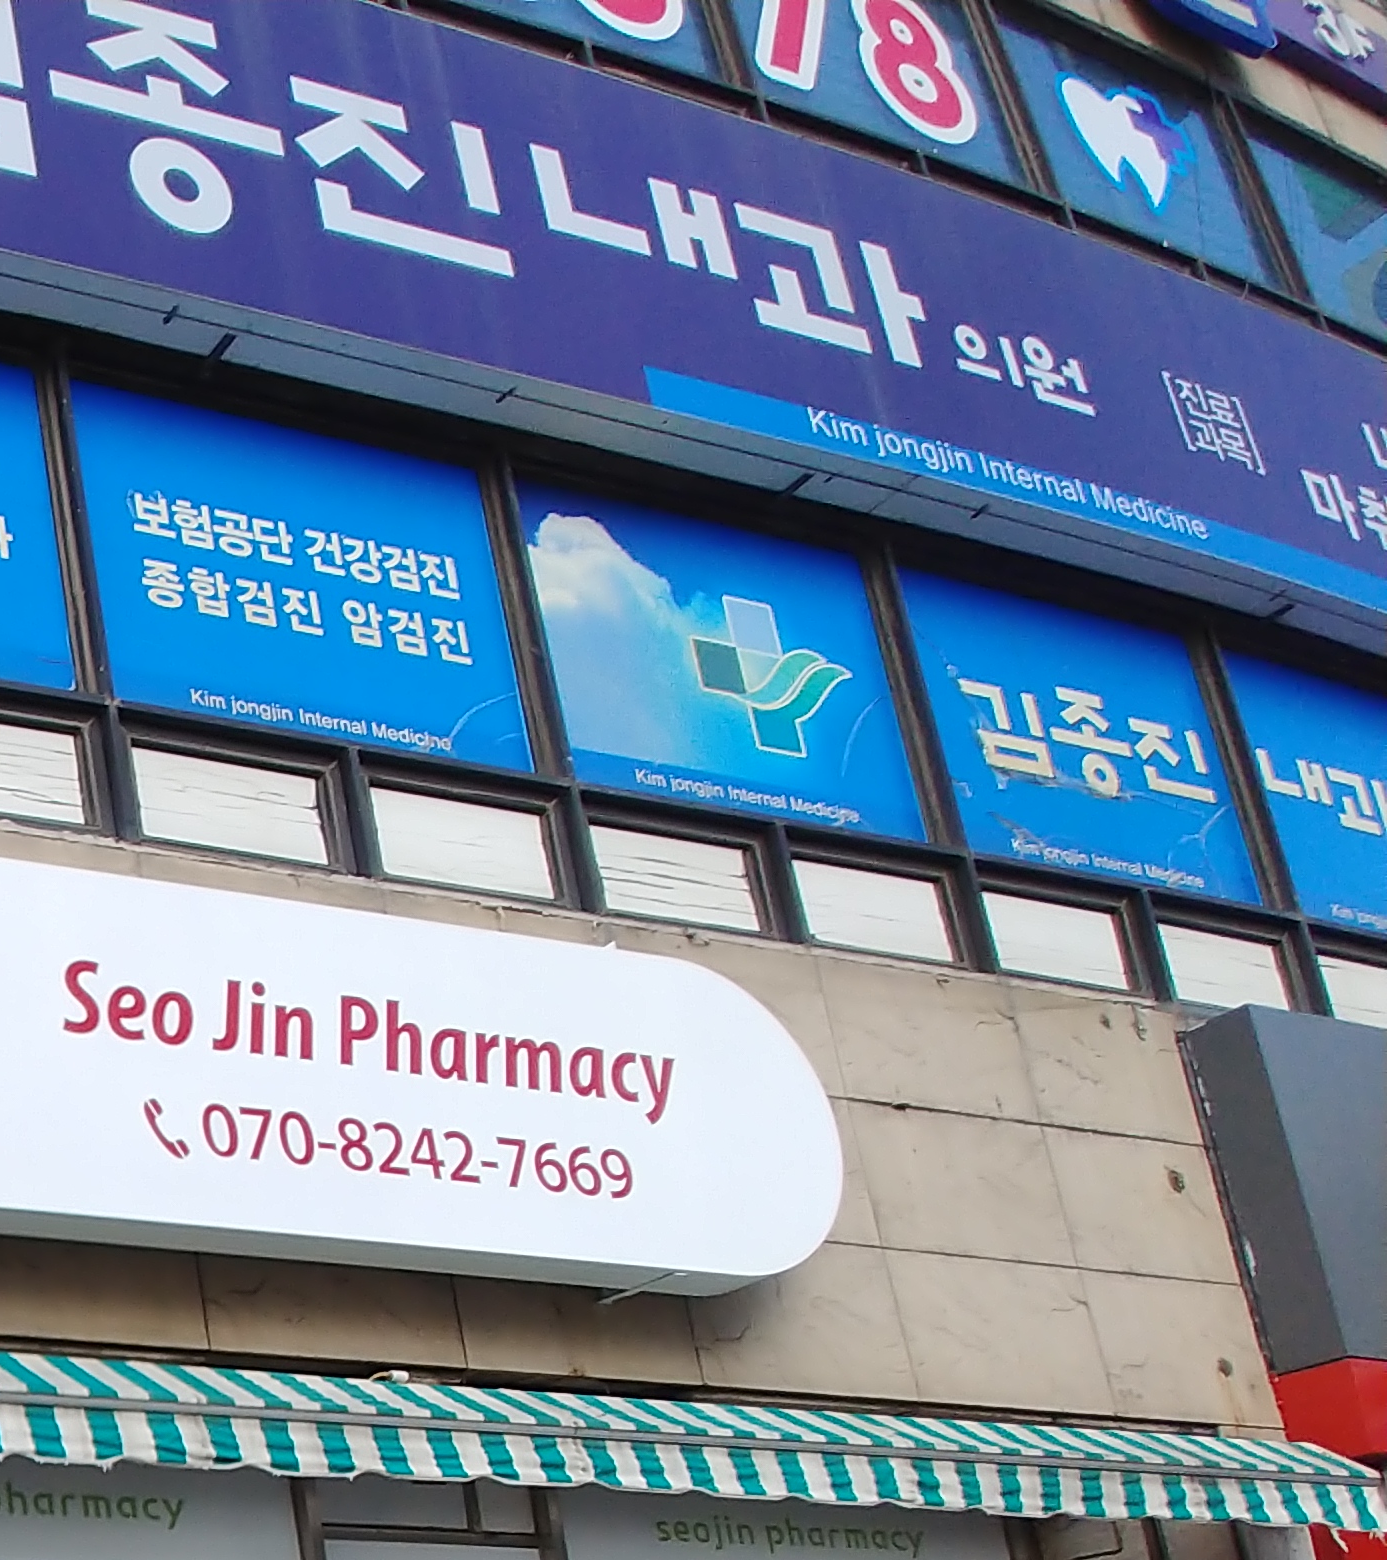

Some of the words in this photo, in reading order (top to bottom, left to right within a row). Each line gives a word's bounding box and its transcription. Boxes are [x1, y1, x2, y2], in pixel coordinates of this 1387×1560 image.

[955, 323, 1095, 416] 의원
[807, 406, 870, 448] Kim
[874, 425, 975, 474] jongjin
[979, 452, 1087, 505] Internal
[1091, 482, 1209, 540] Medicine
[132, 490, 294, 566] 보험공단
[303, 527, 461, 601] 건강검진
[141, 557, 325, 637] 종합검진
[343, 598, 474, 666] 암검진
[189, 687, 226, 711] Kim
[230, 694, 294, 724] jongjin
[299, 707, 368, 736] Internal
[371, 721, 454, 752] Medicine
[957, 678, 1218, 804] 김종진
[634, 768, 667, 788] Kim
[670, 774, 725, 799] jongjin
[728, 785, 788, 810] Internal
[62, 959, 194, 1046] Seo
[212, 979, 314, 1061] Jin
[339, 994, 675, 1126] Pharmacy
[201, 1100, 635, 1200] 070-8242-7669
[656, 1513, 756, 1551] seojin
[766, 1518, 925, 1559] pharmacy
